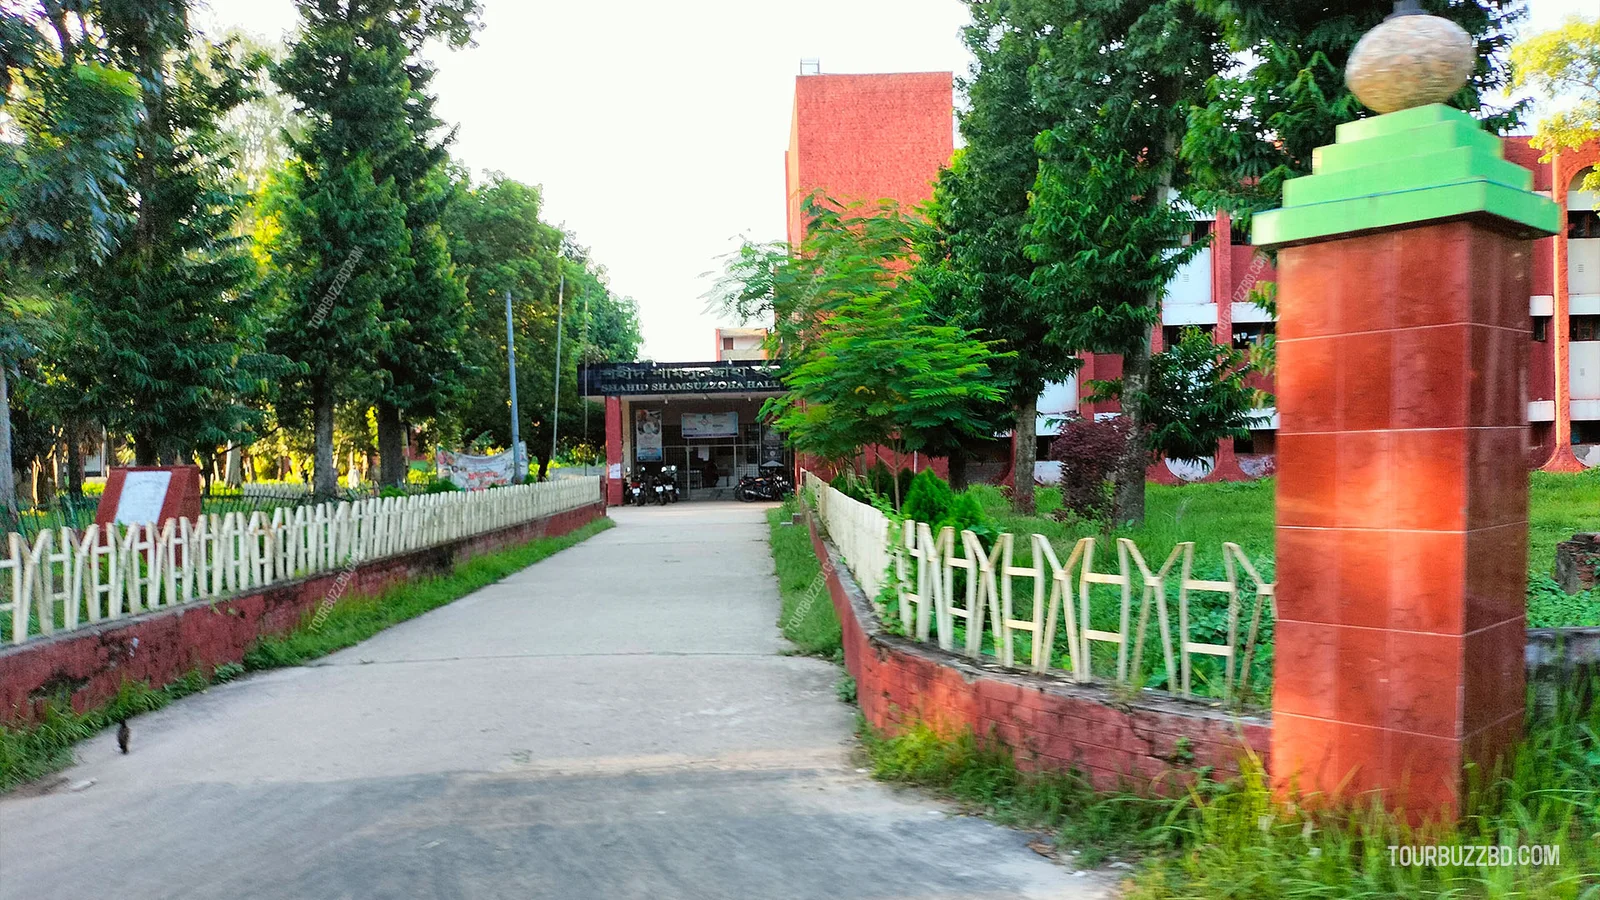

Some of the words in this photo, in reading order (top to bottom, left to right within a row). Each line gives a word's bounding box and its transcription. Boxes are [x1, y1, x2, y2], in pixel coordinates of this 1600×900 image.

[600, 366, 646, 379] শহীদ
[601, 383, 649, 392] SHAHID
[651, 380, 745, 391] SHAMSUZZOHA
[747, 380, 780, 388] HALL
